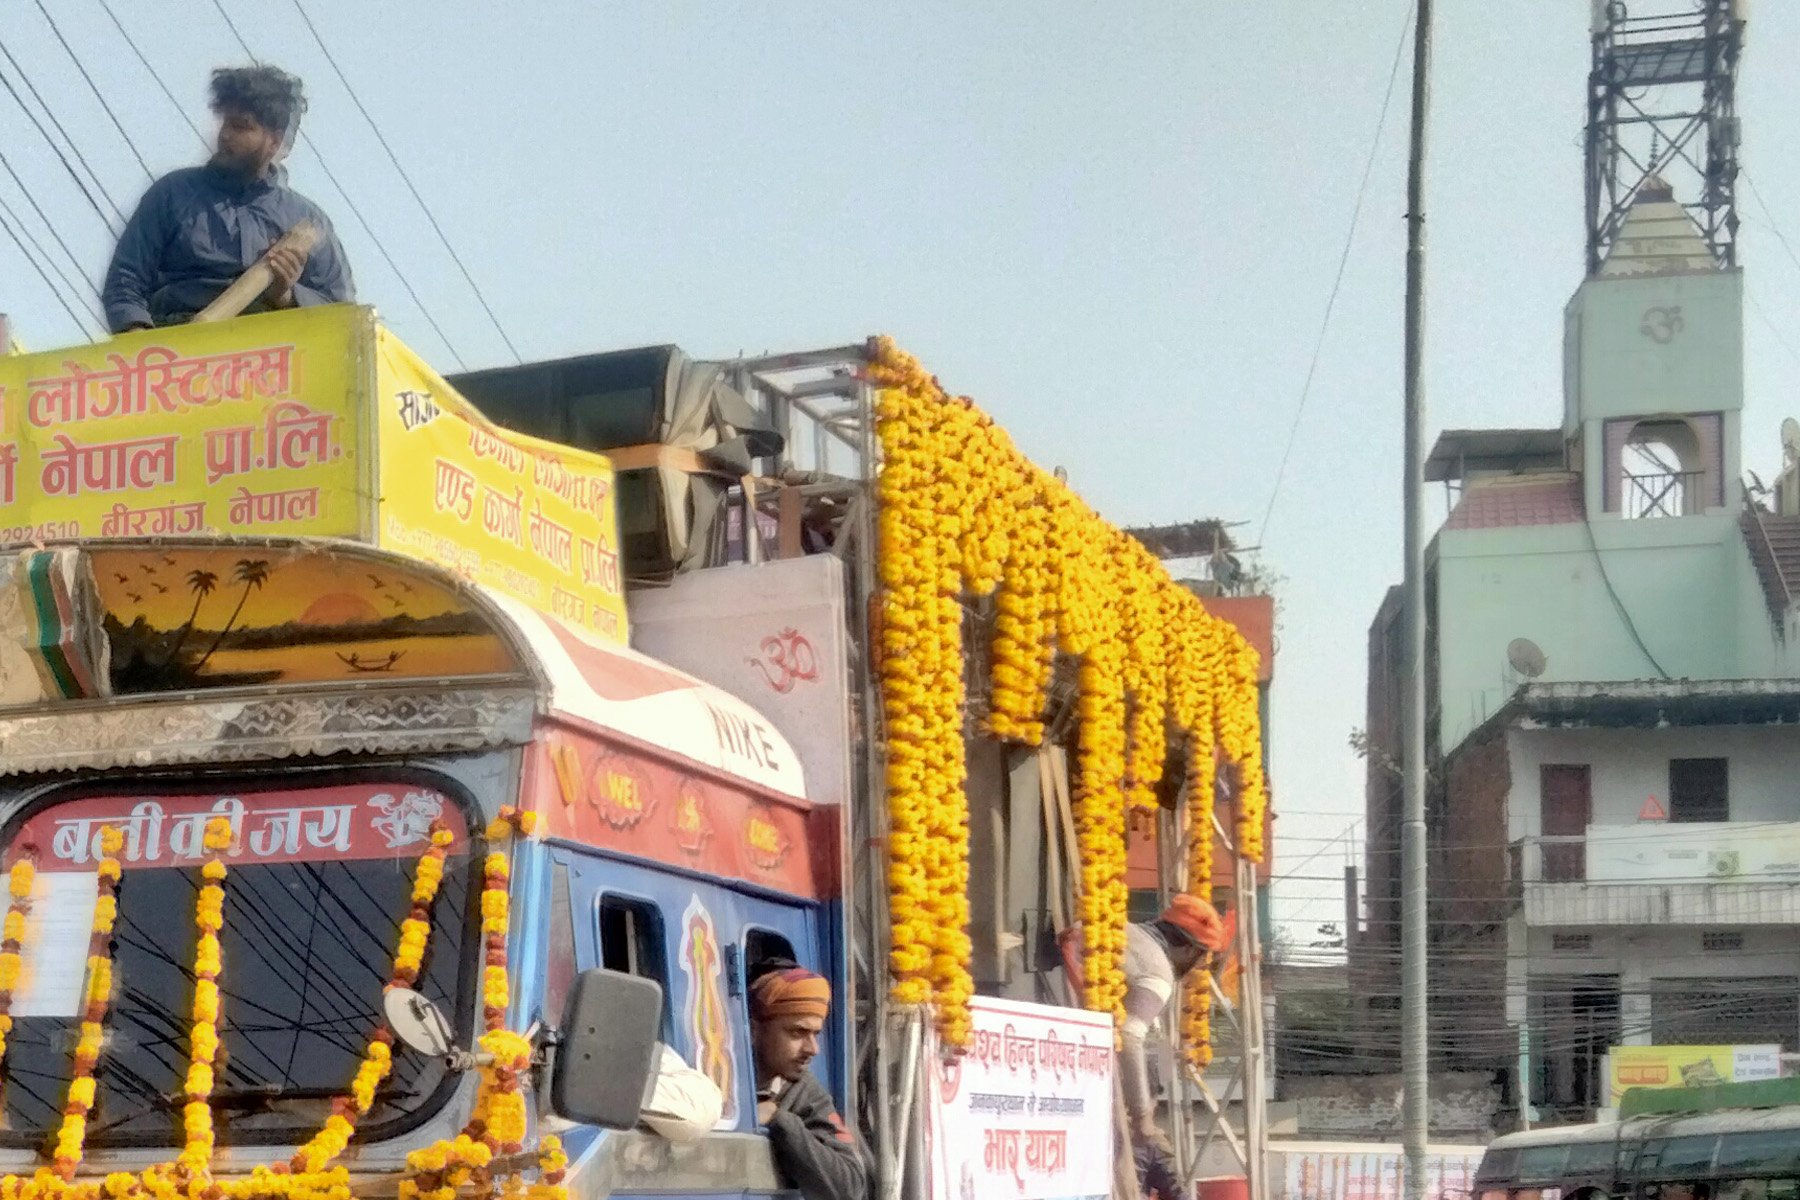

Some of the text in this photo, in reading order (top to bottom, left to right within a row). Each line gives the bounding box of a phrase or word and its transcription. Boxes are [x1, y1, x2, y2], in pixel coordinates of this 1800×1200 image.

[41, 433, 181, 496] नेपाल
[228, 486, 320, 526] नेपाल
[435, 459, 475, 521] एण्ड
[530, 497, 573, 574] नेपाल
[705, 701, 780, 772] NIKE
[52, 797, 358, 864] बली की जय
[1003, 1022, 1038, 1081] हिन्दू
[1024, 1128, 1068, 1178] यात्रा
